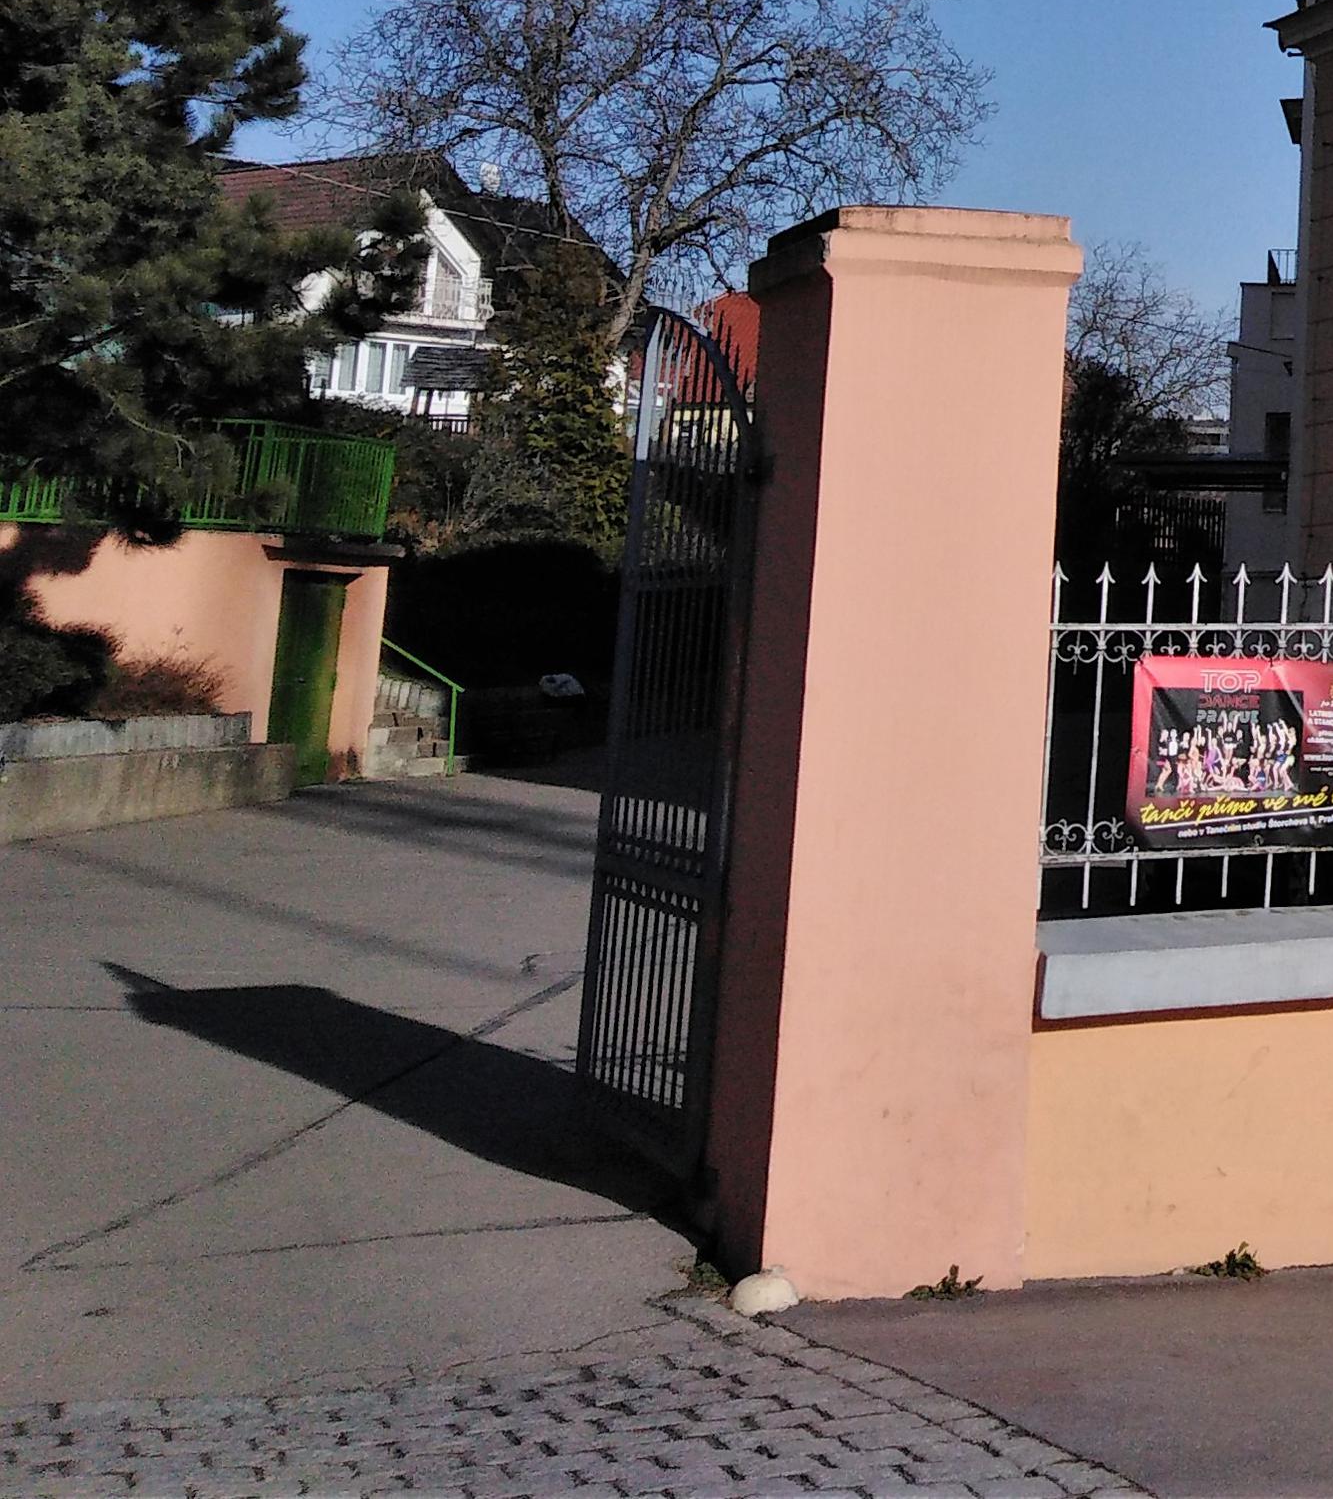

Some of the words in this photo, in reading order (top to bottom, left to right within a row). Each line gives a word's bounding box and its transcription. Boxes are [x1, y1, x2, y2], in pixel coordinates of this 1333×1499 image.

[1199, 669, 1261, 693] TOP
[1198, 693, 1260, 709] DANCE
[1196, 709, 1260, 723] PRAGUE
[1195, 795, 1257, 826] přímo
[1263, 796, 1288, 811] ve
[1292, 786, 1328, 807] své
